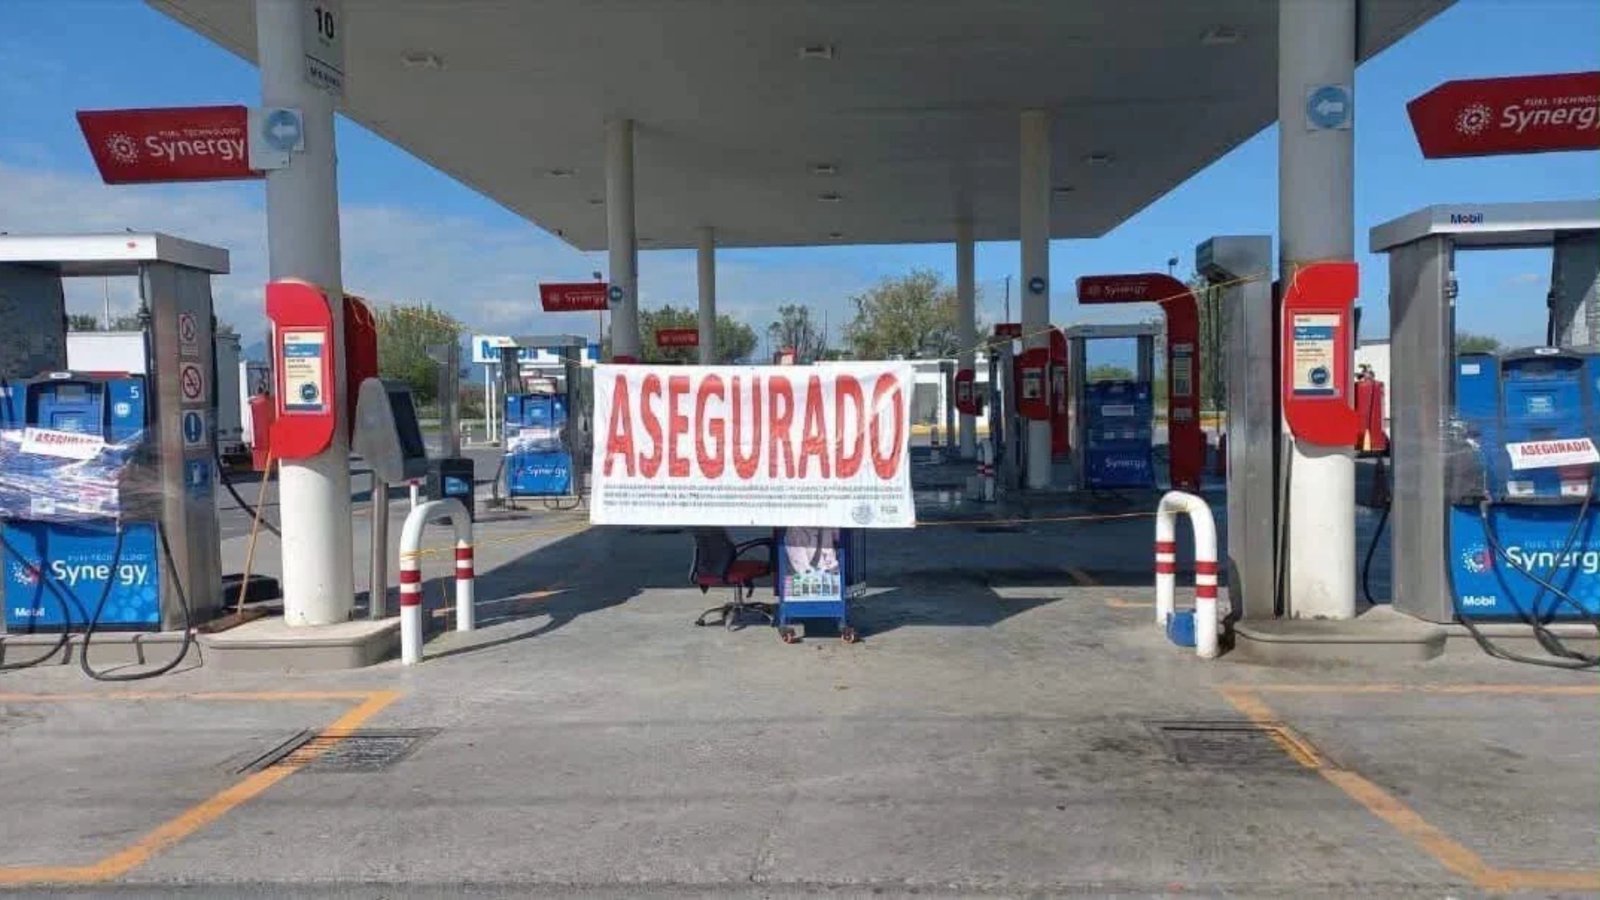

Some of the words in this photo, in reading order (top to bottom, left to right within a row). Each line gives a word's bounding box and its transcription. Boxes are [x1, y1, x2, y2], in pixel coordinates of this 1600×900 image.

[313, 6, 335, 39] 10
[1500, 104, 1600, 132] Synerg
[145, 136, 244, 162] Synergy
[1451, 213, 1484, 224] Mobil
[130, 385, 140, 399] 5
[603, 372, 904, 480] ASEGURADO
[1520, 441, 1591, 456] ASEGURADO
[1506, 546, 1600, 574] Synerg
[1463, 596, 1496, 606] Mobil
